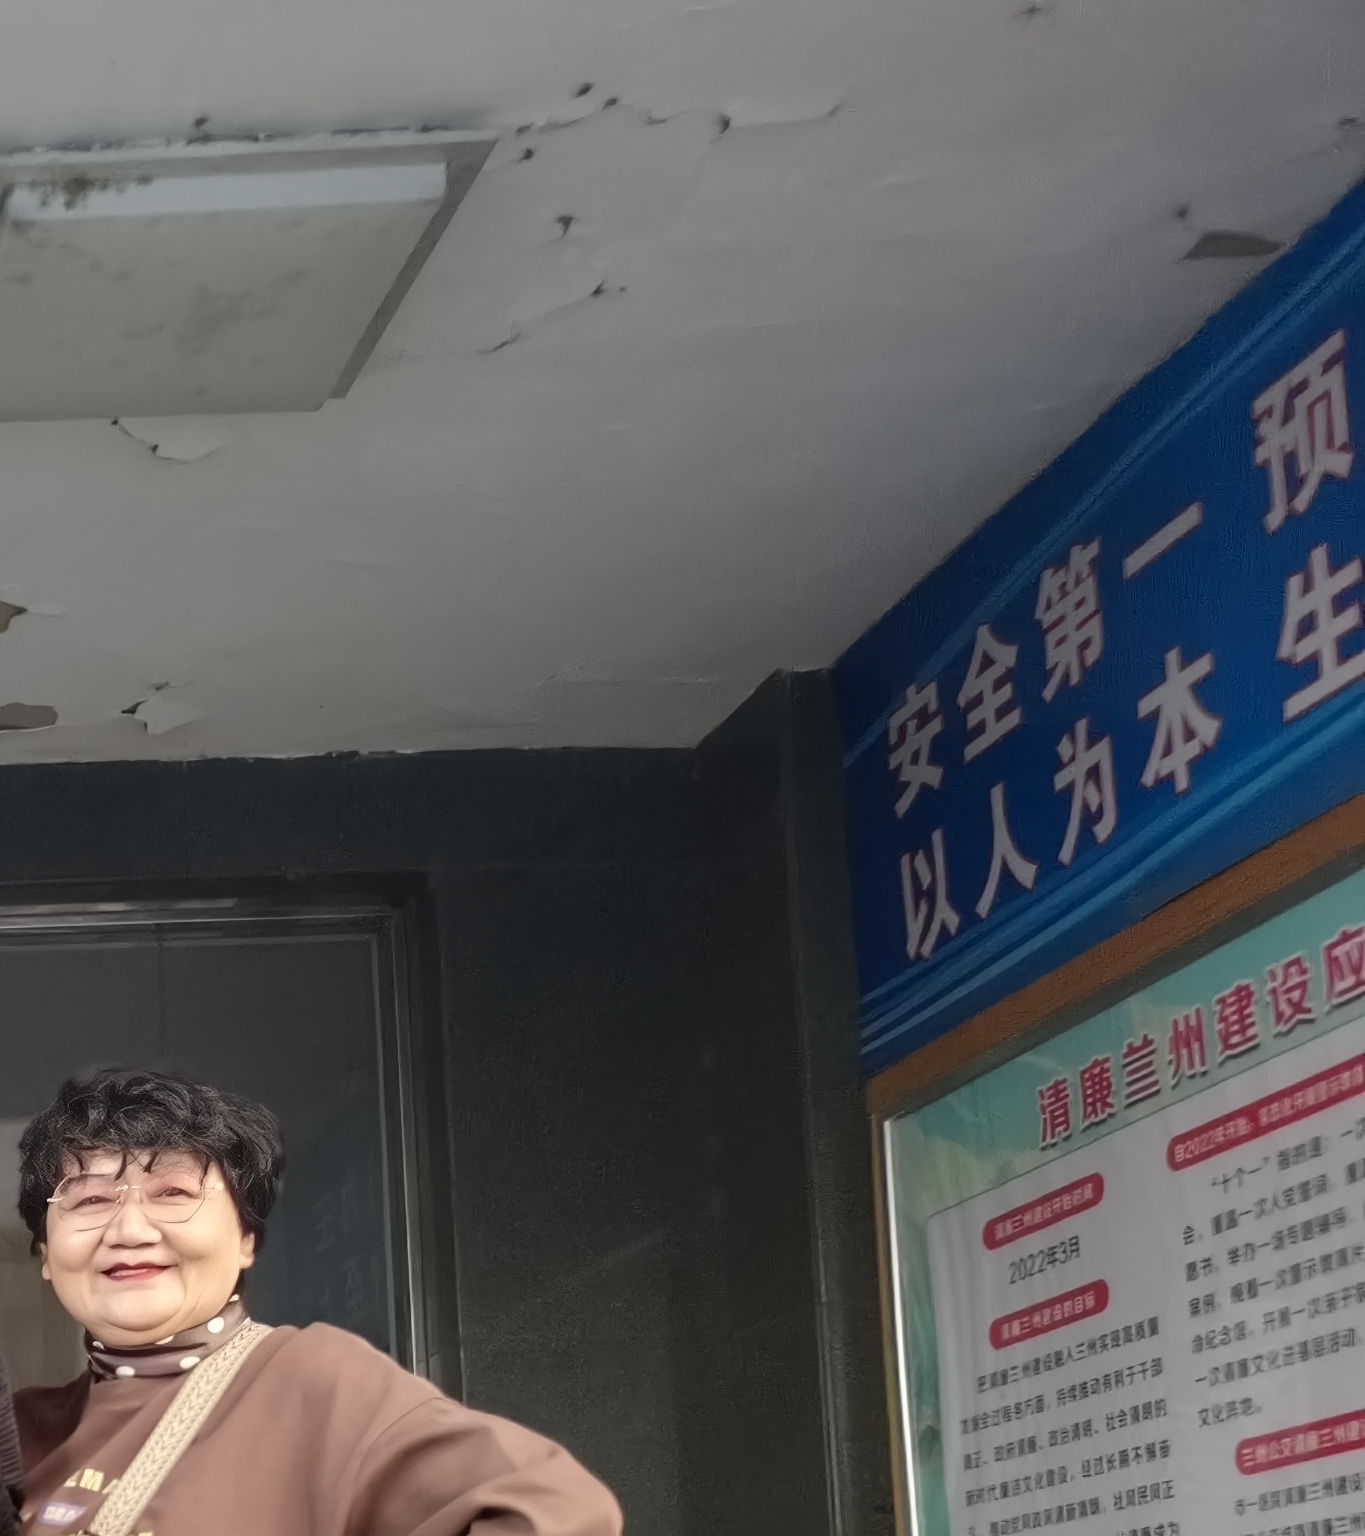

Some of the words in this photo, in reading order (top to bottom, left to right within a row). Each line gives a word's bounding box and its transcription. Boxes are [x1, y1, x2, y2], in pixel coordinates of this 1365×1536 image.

[887, 502, 1203, 819] 安全第一
[1251, 328, 1355, 536] 预
[899, 646, 1223, 961] 以人为本
[1275, 542, 1365, 723] 生
[1009, 1235, 1081, 1284] 2022年3月
